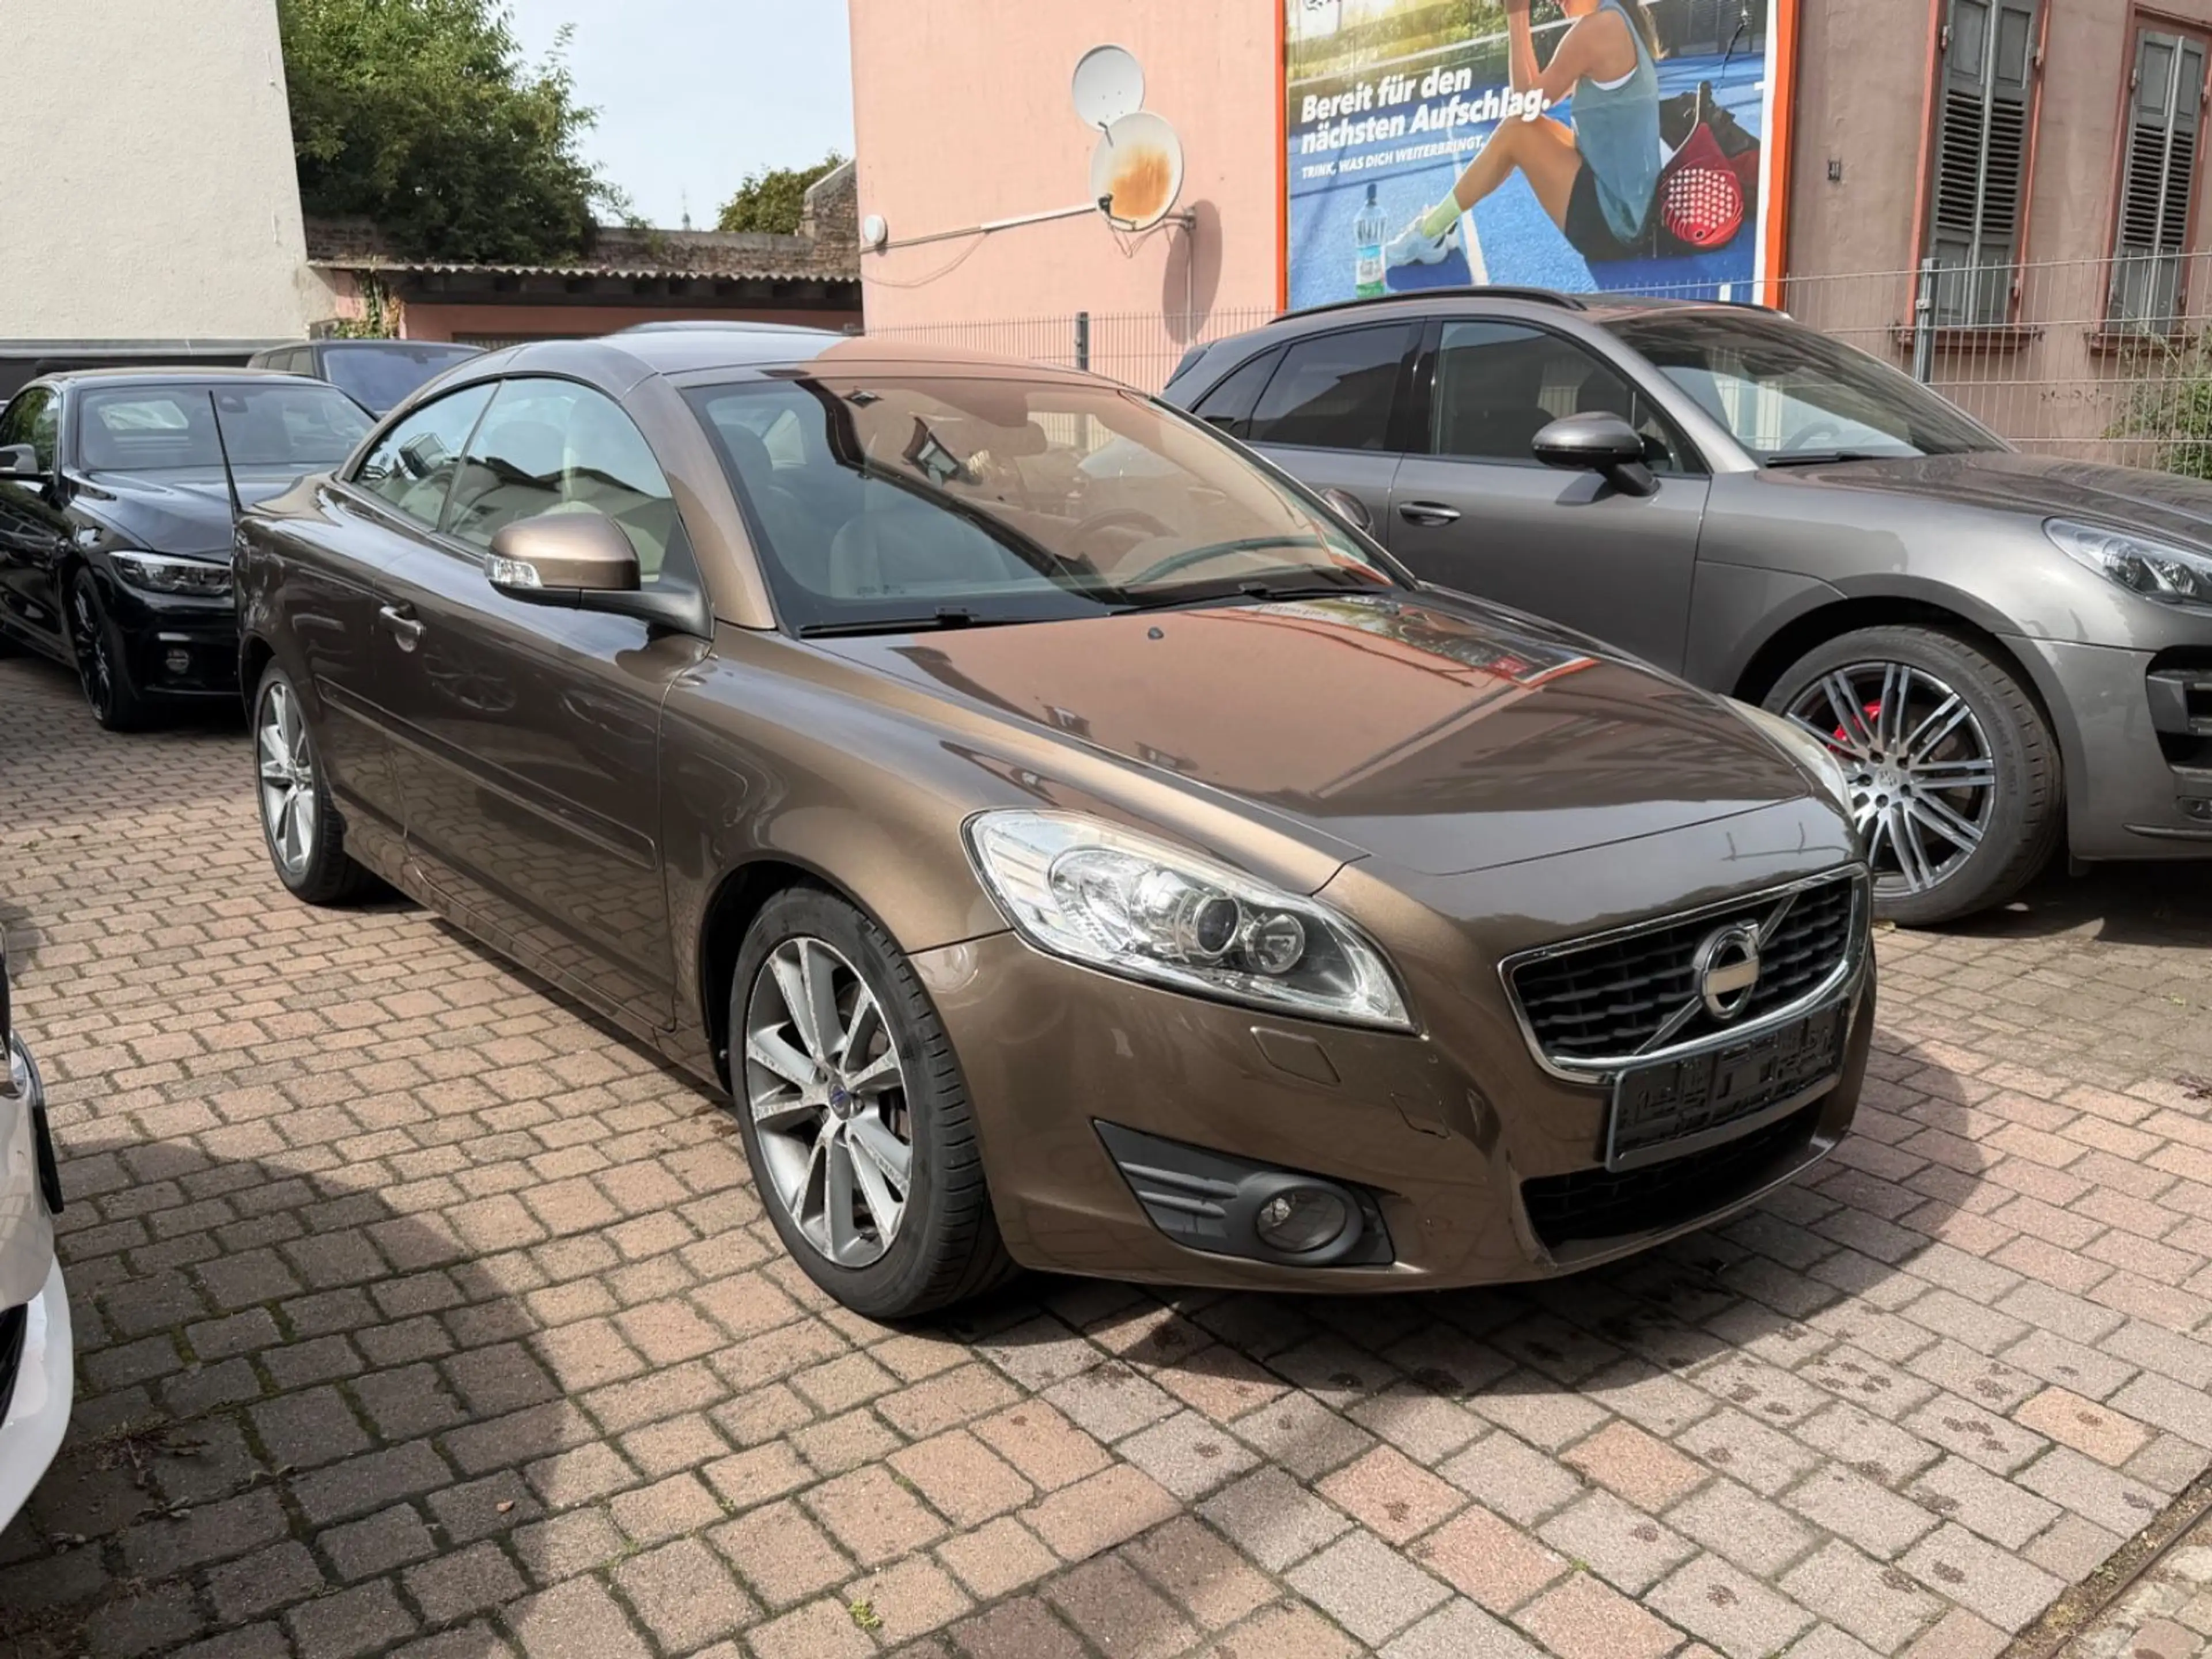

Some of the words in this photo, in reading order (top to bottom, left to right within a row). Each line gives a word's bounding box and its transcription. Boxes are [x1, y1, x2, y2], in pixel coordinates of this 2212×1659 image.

[1301, 81, 1374, 123] Bereit
[1377, 74, 1417, 108] für
[1421, 65, 1472, 99] den
[1301, 114, 1406, 155] nächsten
[1409, 87, 1551, 134] Aufschlag.
[1339, 156, 1365, 173] WAS
[1365, 150, 1393, 169] DICH
